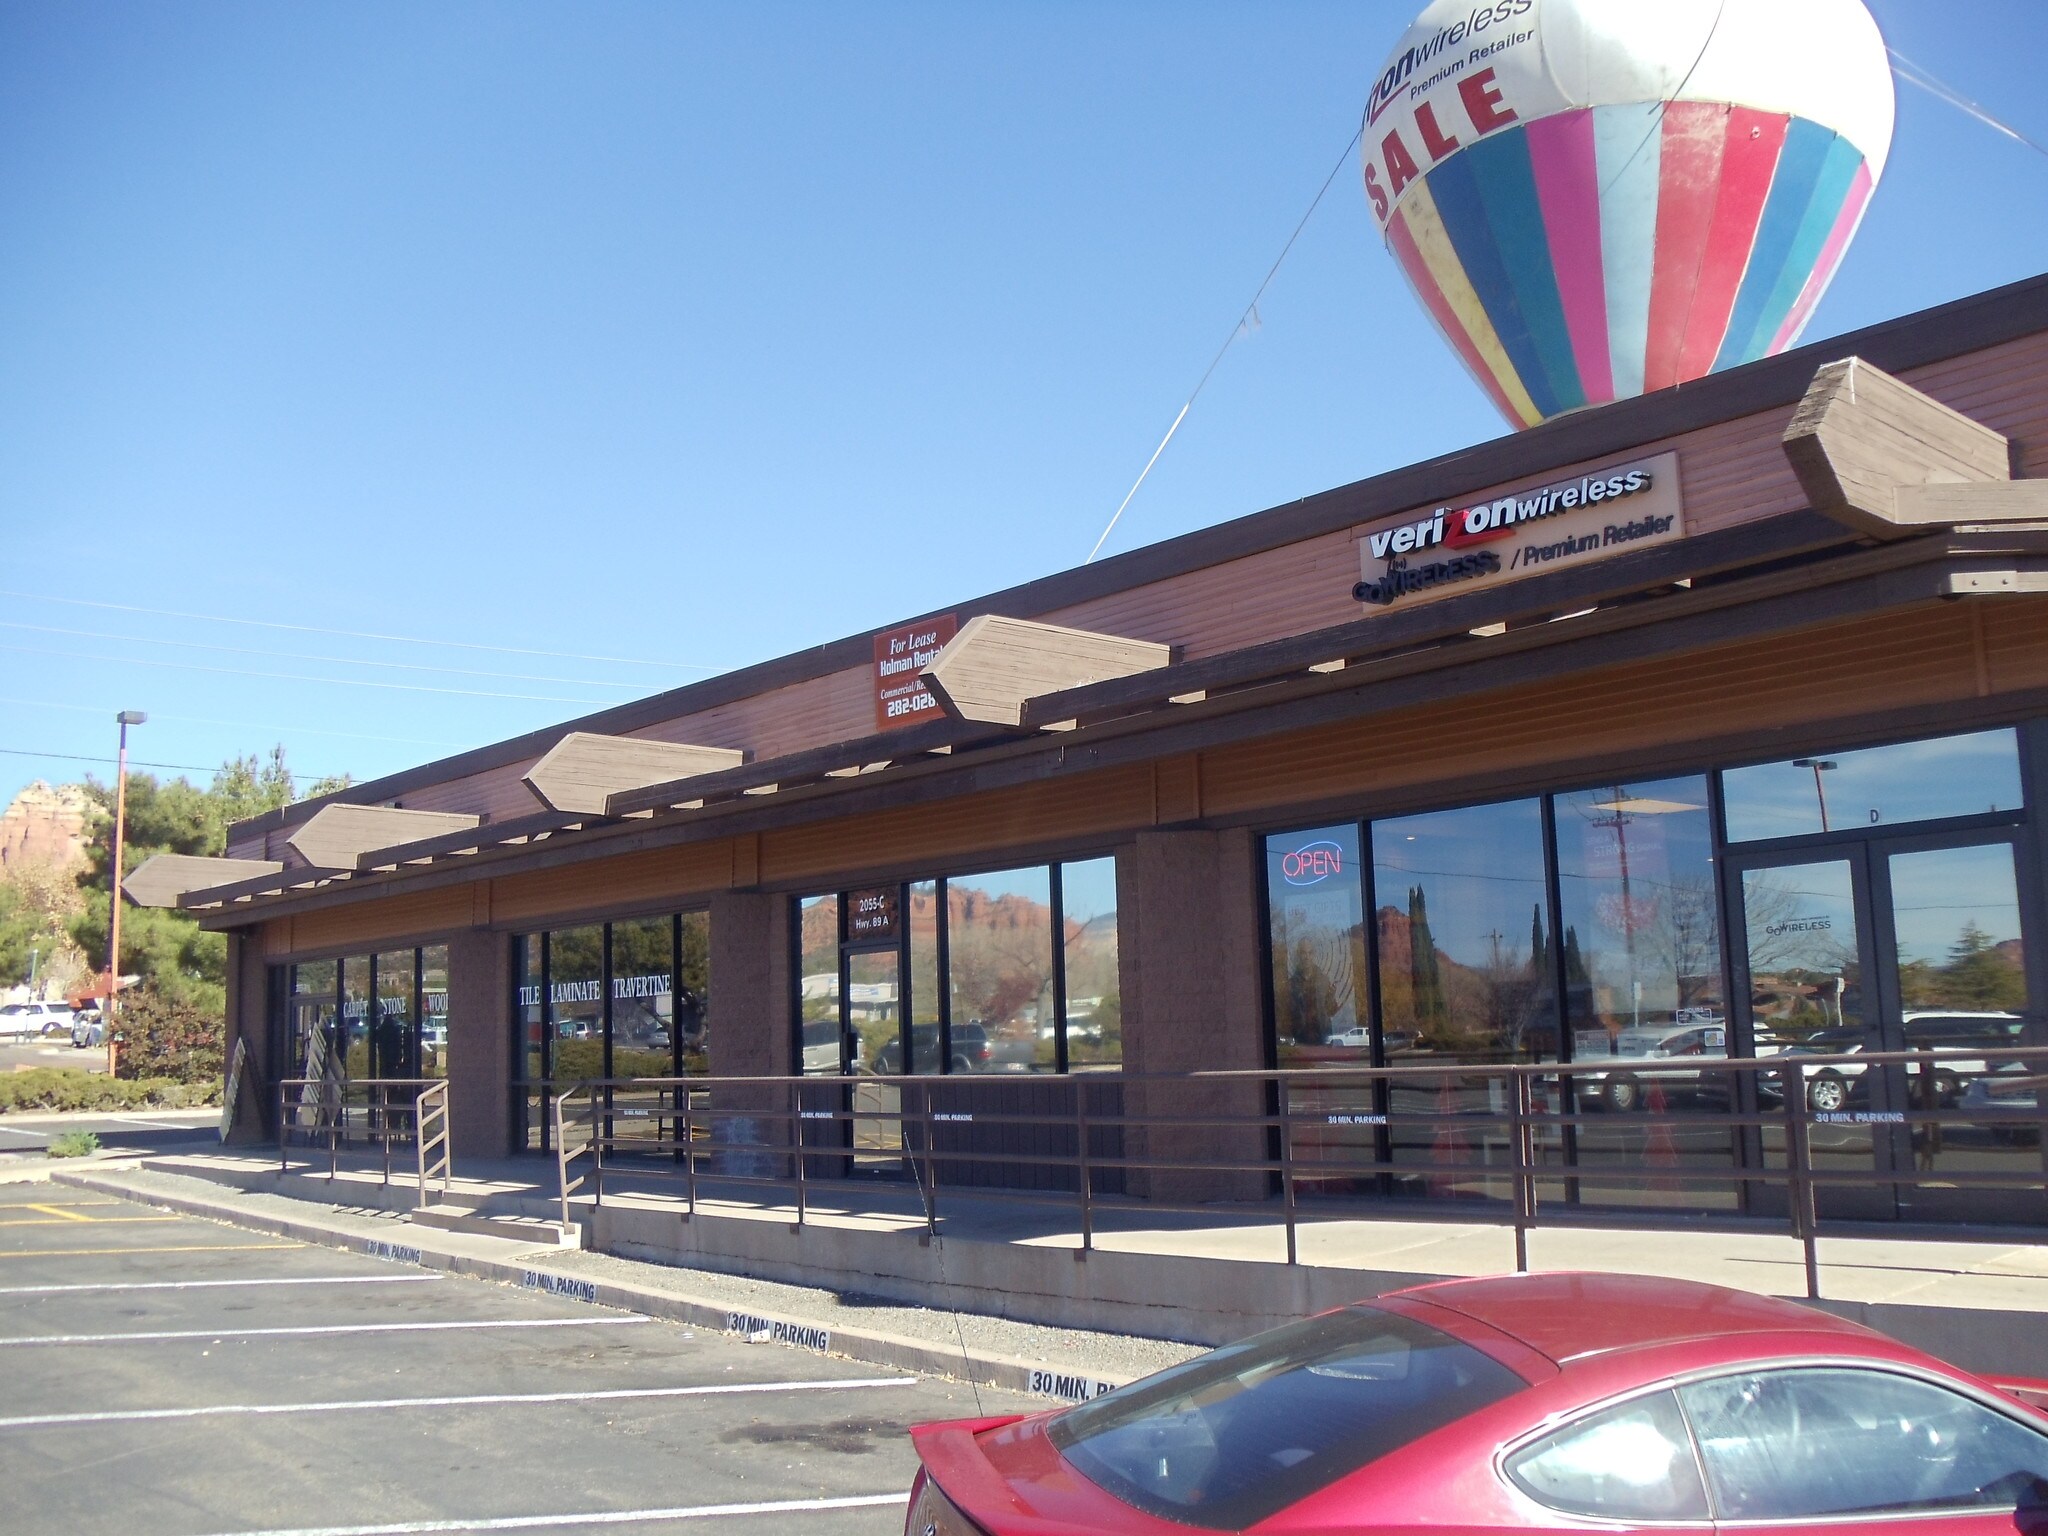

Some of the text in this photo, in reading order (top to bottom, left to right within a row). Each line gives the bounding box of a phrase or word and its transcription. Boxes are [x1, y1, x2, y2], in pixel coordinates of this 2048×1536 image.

[1410, 29, 1534, 100] Premium Retailer
[1364, 66, 1519, 222] SALE
[1603, 515, 1675, 547] Retailer
[889, 632, 937, 655] For Lease
[880, 656, 913, 677] Holman
[1870, 809, 1879, 823] D
[1282, 849, 1341, 877] OPEN
[859, 895, 885, 912] 2055-C
[855, 915, 889, 930] Hwy. 89 A
[519, 974, 672, 1006] TILE LAMINATE TRAVERTINE
[343, 993, 448, 1018] CARPET STONE WOO
[1354, 1115, 1387, 1124] PARKING
[1815, 1112, 1905, 1123] 30 MIN. PARKING
[391, 1245, 421, 1263] PARKING
[525, 1271, 595, 1299] 30 MIN. PARKING
[731, 1313, 745, 1332] 30
[773, 1321, 827, 1352] PARKING
[1032, 1371, 1053, 1393] 30
[1055, 1375, 1090, 1401] MIN.
